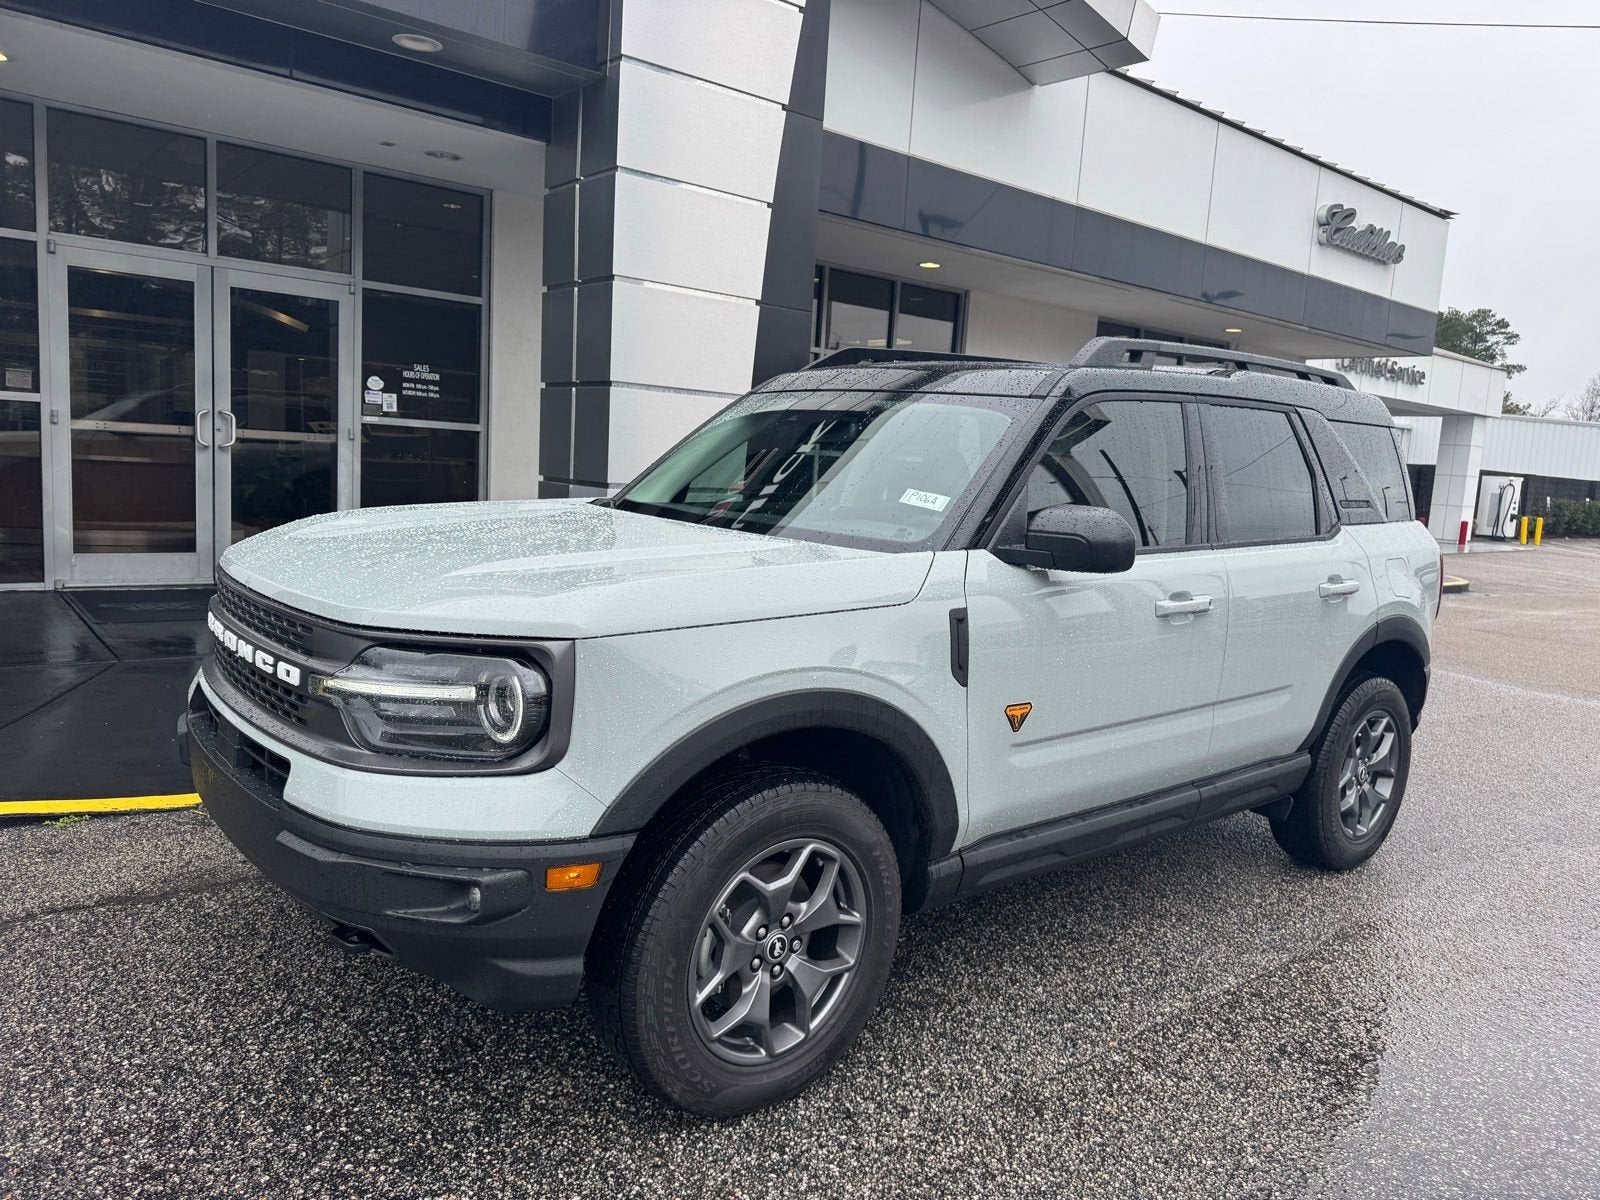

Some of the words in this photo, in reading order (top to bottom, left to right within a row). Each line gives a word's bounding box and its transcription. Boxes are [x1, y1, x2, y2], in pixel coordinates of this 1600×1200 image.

[1317, 203, 1406, 265] Cadillac
[402, 370, 415, 379] HOURS
[413, 363, 430, 373] SALES
[1341, 357, 1388, 380] Certified
[1388, 361, 1426, 386] Service
[663, 956, 717, 1092] SCORPION
